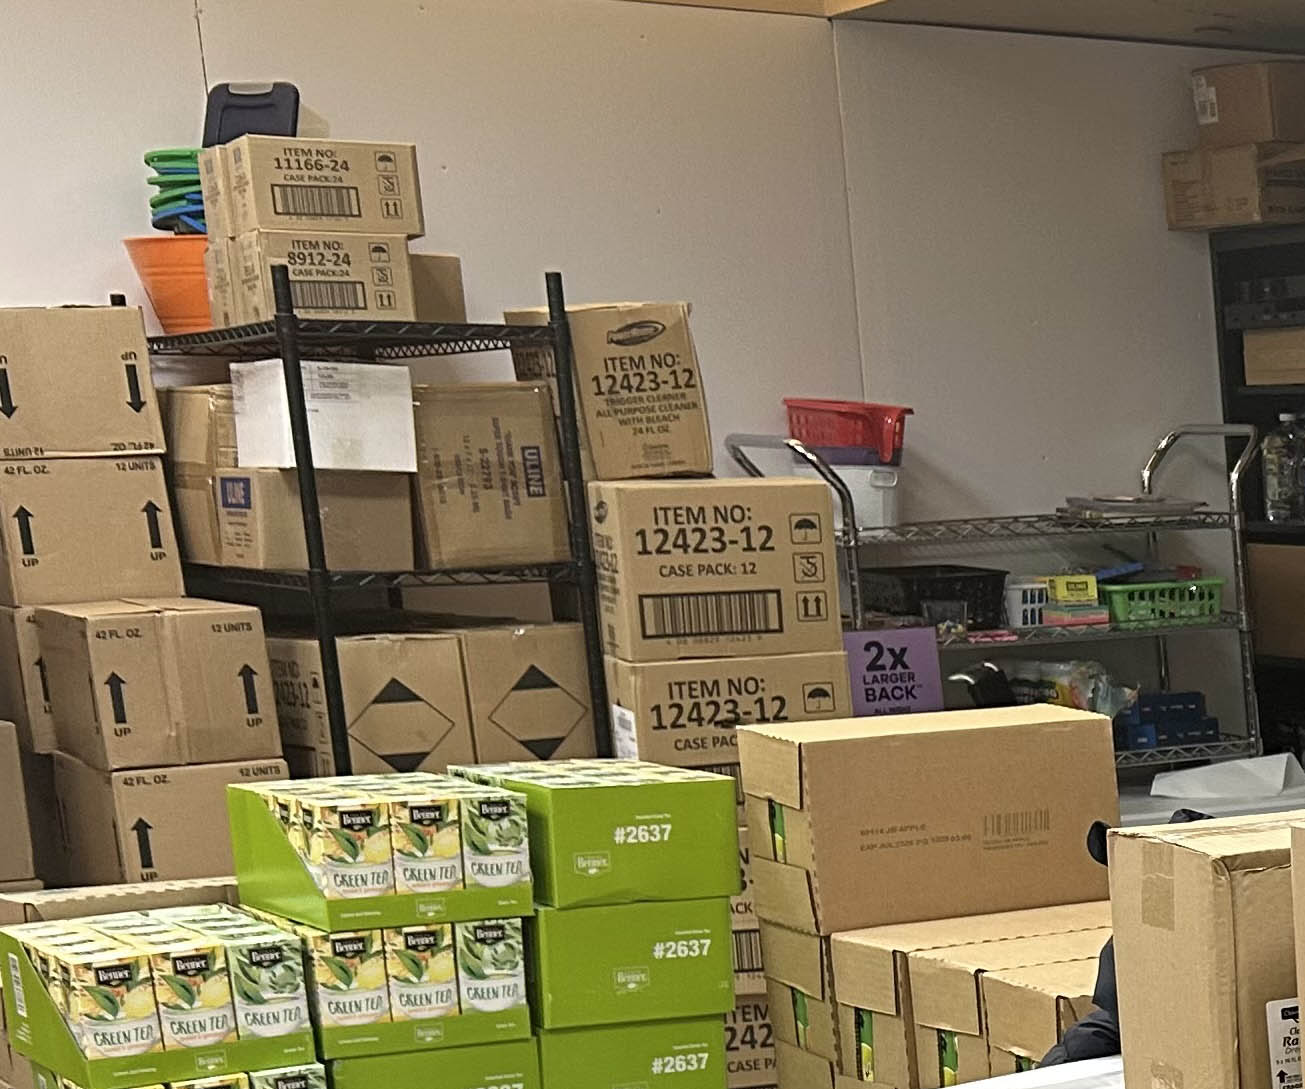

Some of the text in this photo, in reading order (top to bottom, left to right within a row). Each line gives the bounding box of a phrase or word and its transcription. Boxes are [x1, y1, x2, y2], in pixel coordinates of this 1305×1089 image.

[274, 157, 350, 172] 11166-24
[292, 240, 320, 250] ITEM
[287, 252, 351, 267] 8912-24
[604, 352, 680, 373] ITEM NO:
[592, 368, 696, 396] 12423-12
[614, 406, 656, 416] PURPOSE
[524, 449, 544, 496] ULINE
[653, 505, 752, 526] ITEM NO:
[635, 525, 775, 555] 12423-12
[659, 562, 757, 578] CASE PACK: 12
[225, 622, 252, 632] UNITS
[863, 641, 911, 672] 2x
[863, 672, 916, 685] LARGER
[668, 676, 765, 700] ITEM NO:
[650, 695, 789, 731] 12423-12
[246, 718, 262, 728] UP
[674, 736, 708, 751] CASE
[613, 823, 672, 844] #2637
[402, 867, 437, 881] GREEN
[470, 861, 505, 875] GREEN
[333, 872, 368, 888] GREEN
[653, 939, 712, 960] #2637
[400, 992, 433, 1007] GREEN
[467, 986, 499, 1001] GREEN
[328, 999, 362, 1014] GREEN
[244, 1010, 280, 1026] GREEN
[170, 1019, 208, 1035] GREEN
[93, 1030, 132, 1047] GREEN
[651, 1052, 709, 1075] #2637
[727, 1060, 761, 1074] CASE
